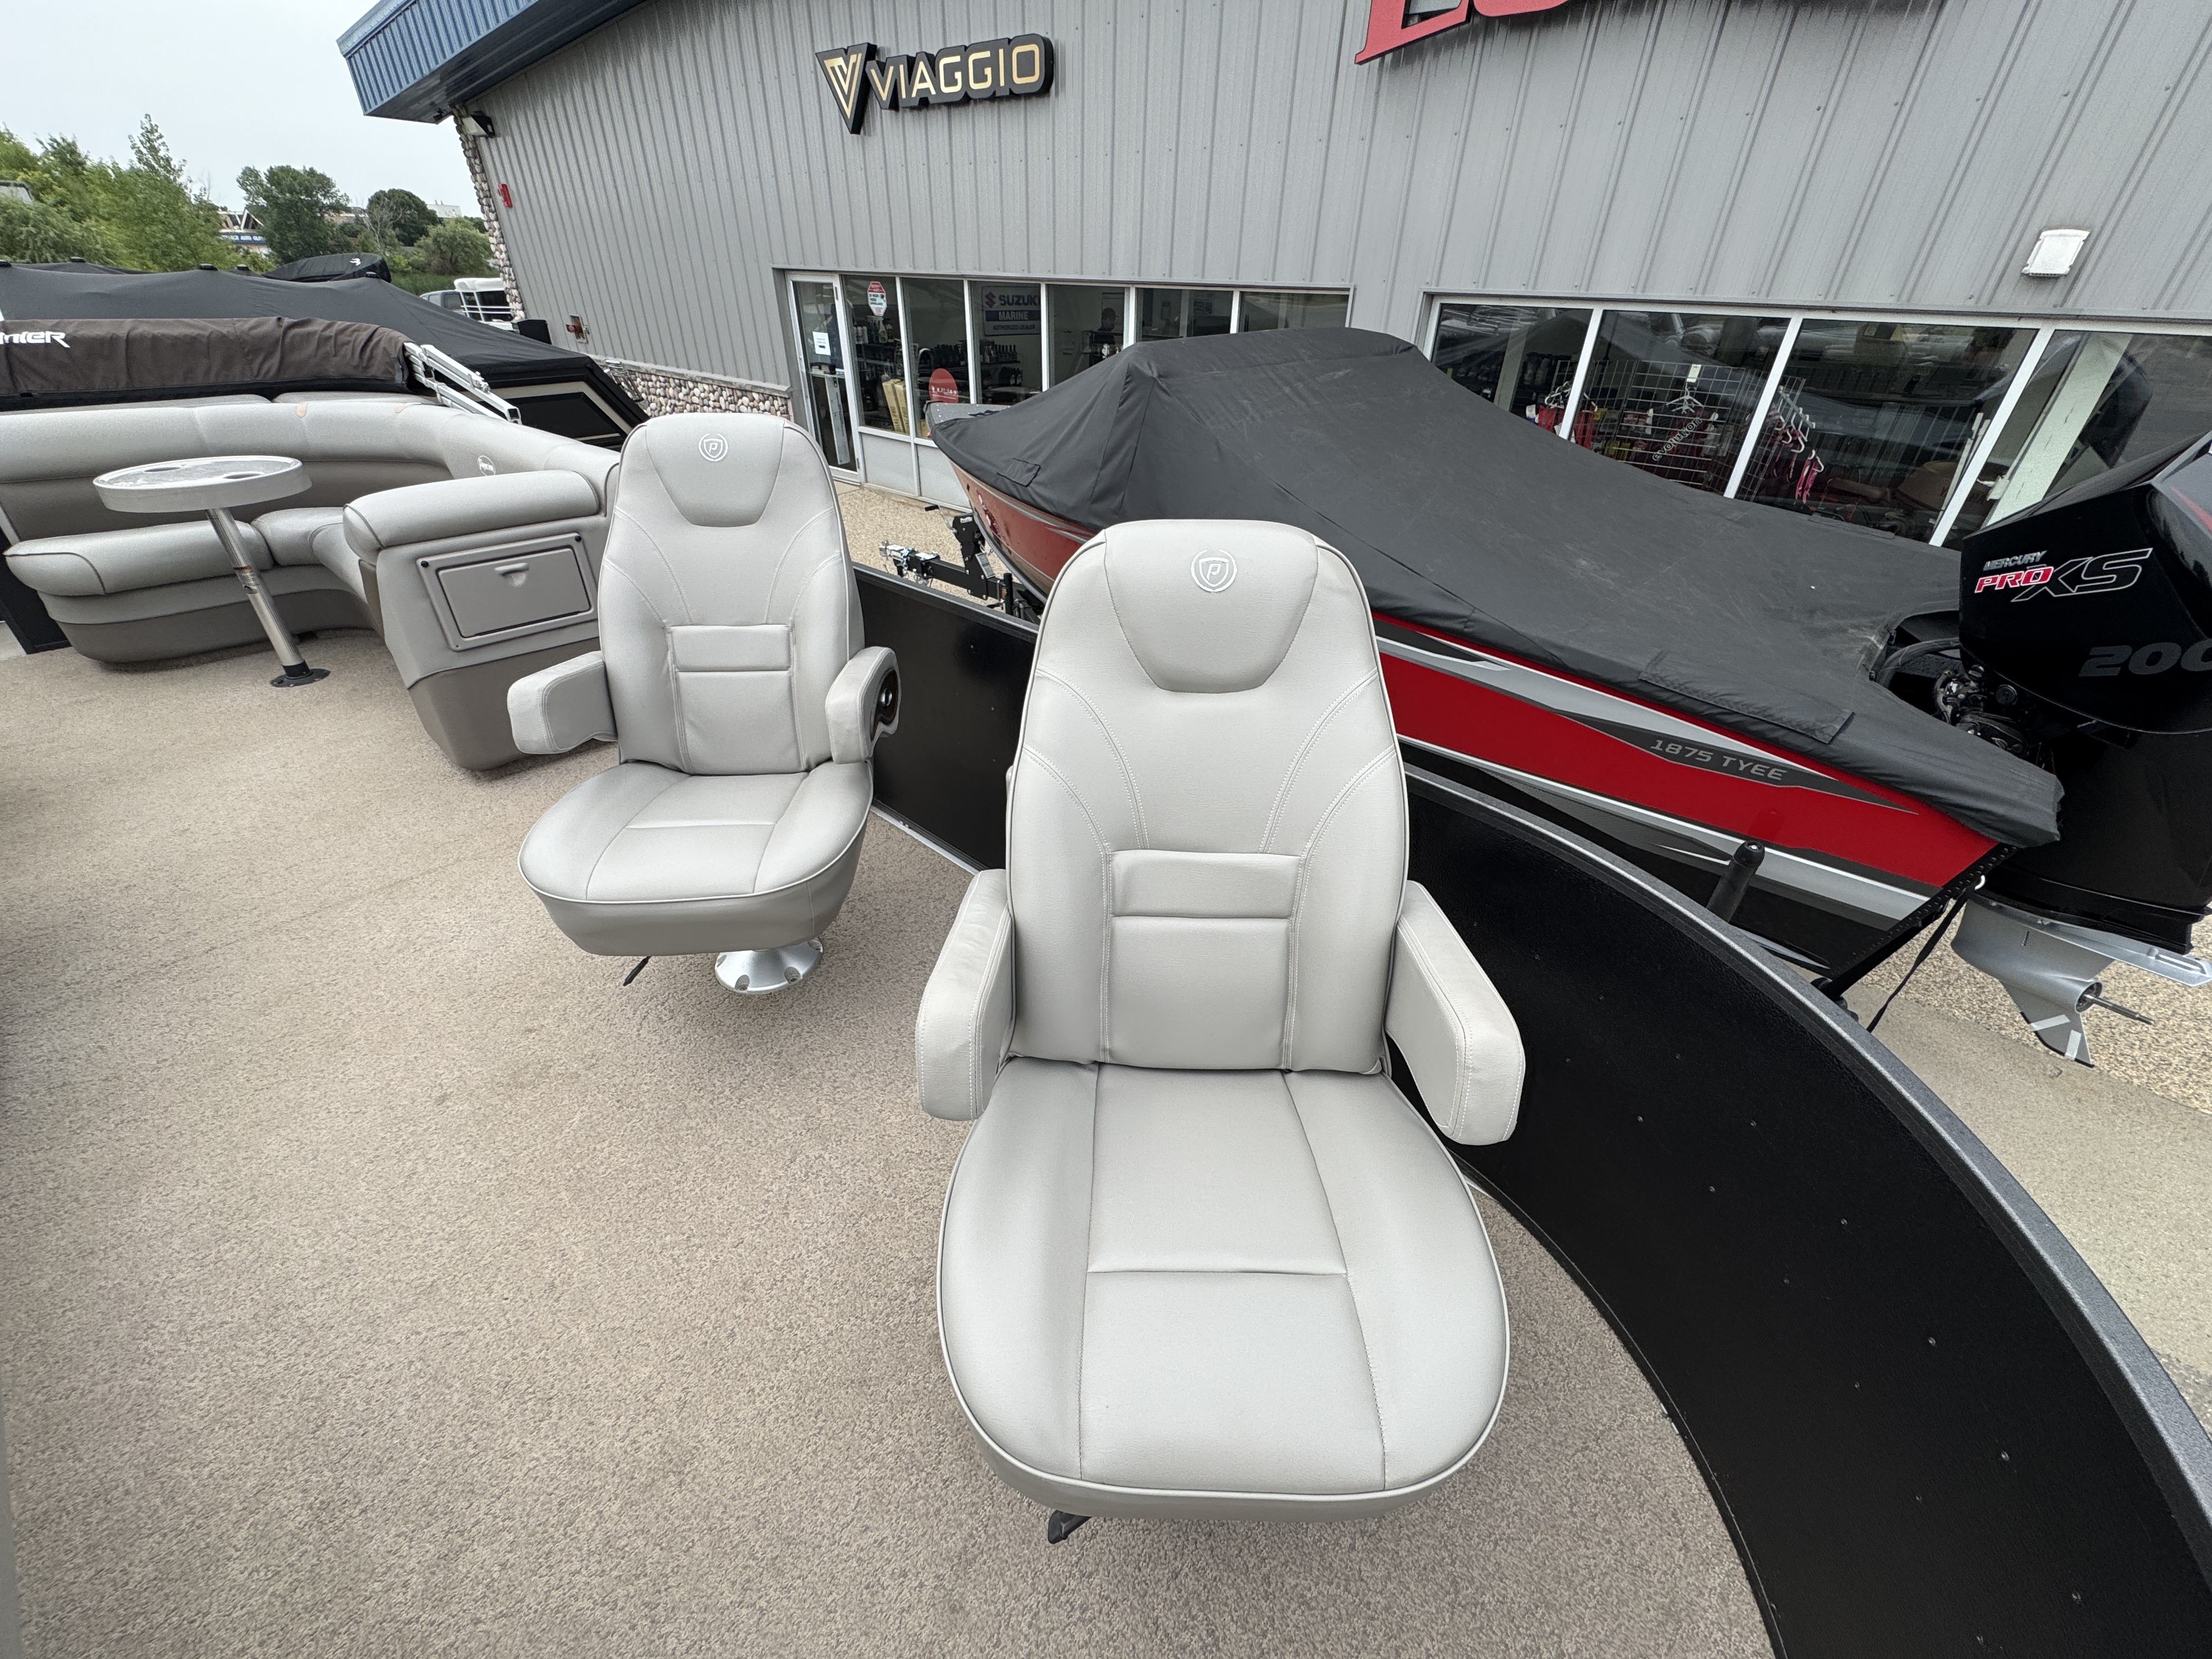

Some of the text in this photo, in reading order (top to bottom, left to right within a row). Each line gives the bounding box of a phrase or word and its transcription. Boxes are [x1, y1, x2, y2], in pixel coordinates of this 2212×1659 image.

[870, 43, 1041, 101] VIAGGIO
[998, 311, 1029, 320] MARINE
[1652, 417, 1703, 461] evolution
[1974, 548, 2153, 602] PRO XS
[1983, 550, 2048, 572] MERCURY
[2078, 639, 2212, 677] 200
[1650, 740, 1788, 781] 1875 TYEE
